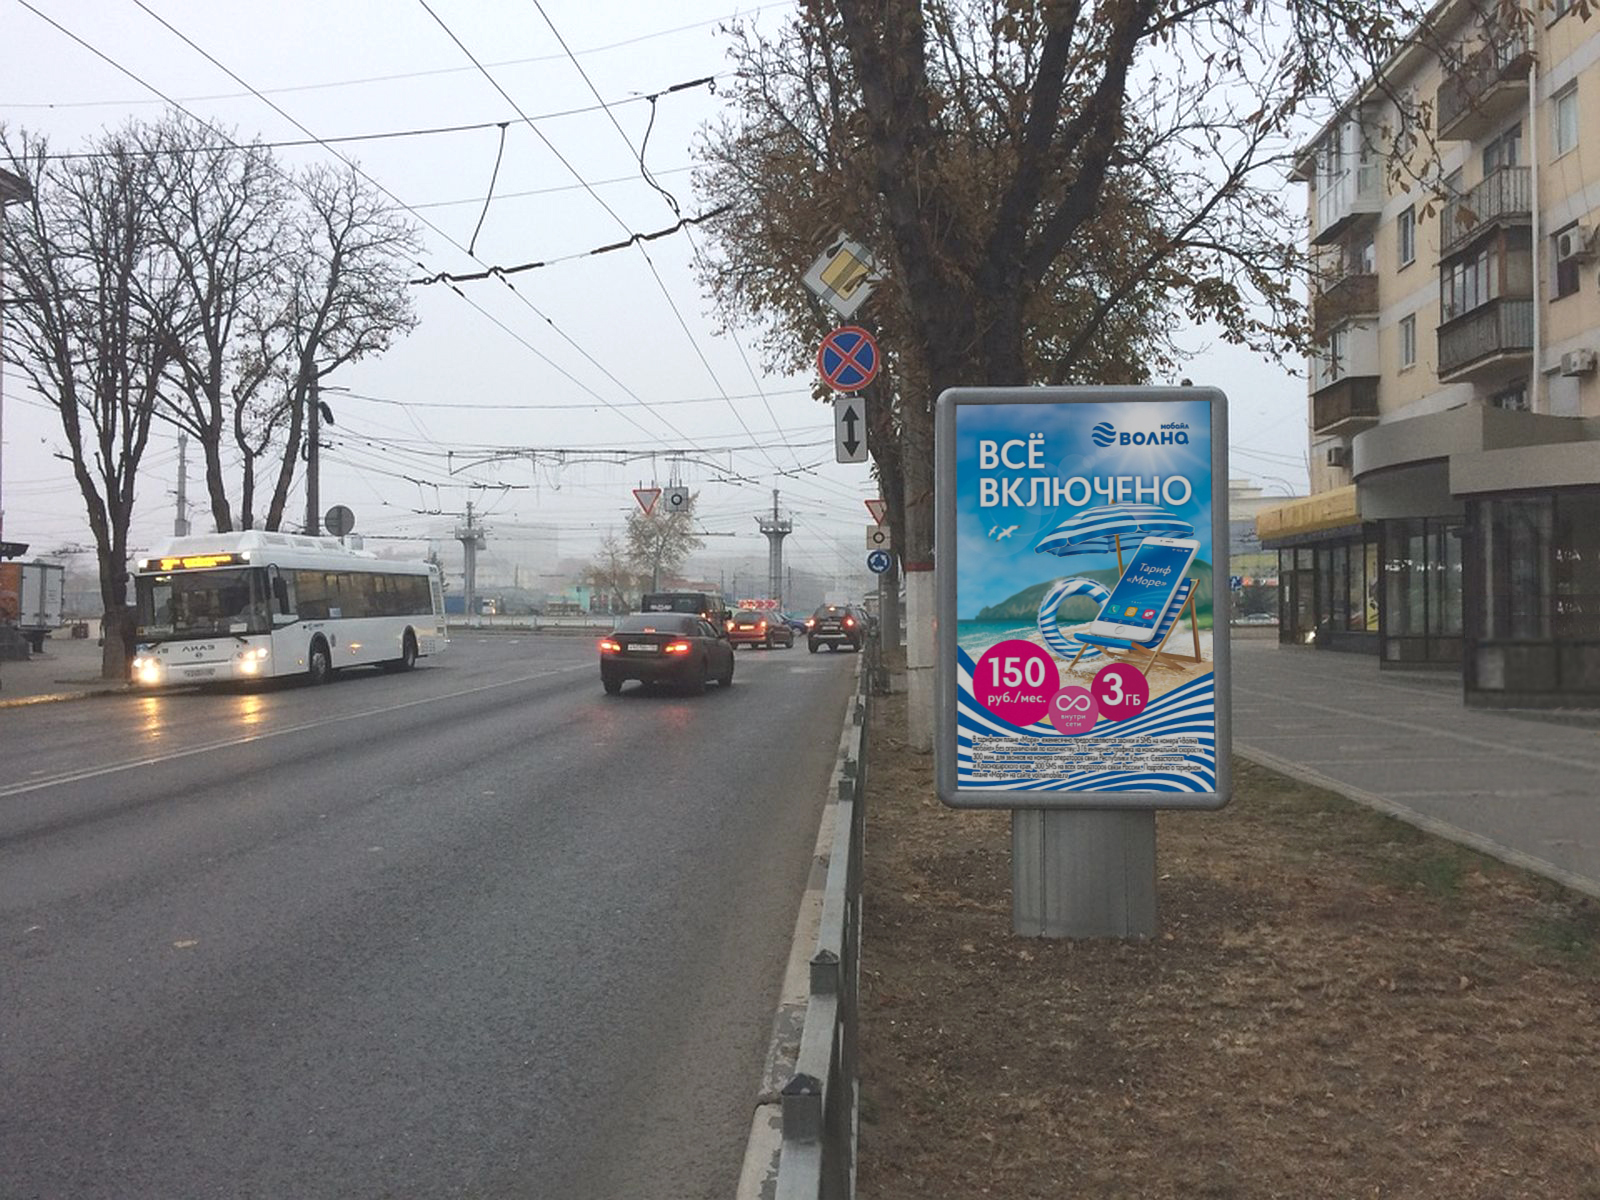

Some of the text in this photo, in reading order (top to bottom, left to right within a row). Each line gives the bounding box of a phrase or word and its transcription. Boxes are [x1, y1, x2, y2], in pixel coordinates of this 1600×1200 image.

[1160, 421, 1189, 430] мобайл
[979, 432, 1046, 470] ВСЁ
[979, 475, 1193, 508] ВКЛЮЧЕНО
[1140, 562, 1172, 577] Тариф
[1126, 575, 1167, 588] «Море»
[987, 656, 1046, 688] 150
[1101, 672, 1141, 706] 3 ГБ
[987, 691, 1047, 707] руб./мес.
[1060, 714, 1086, 722] внутри
